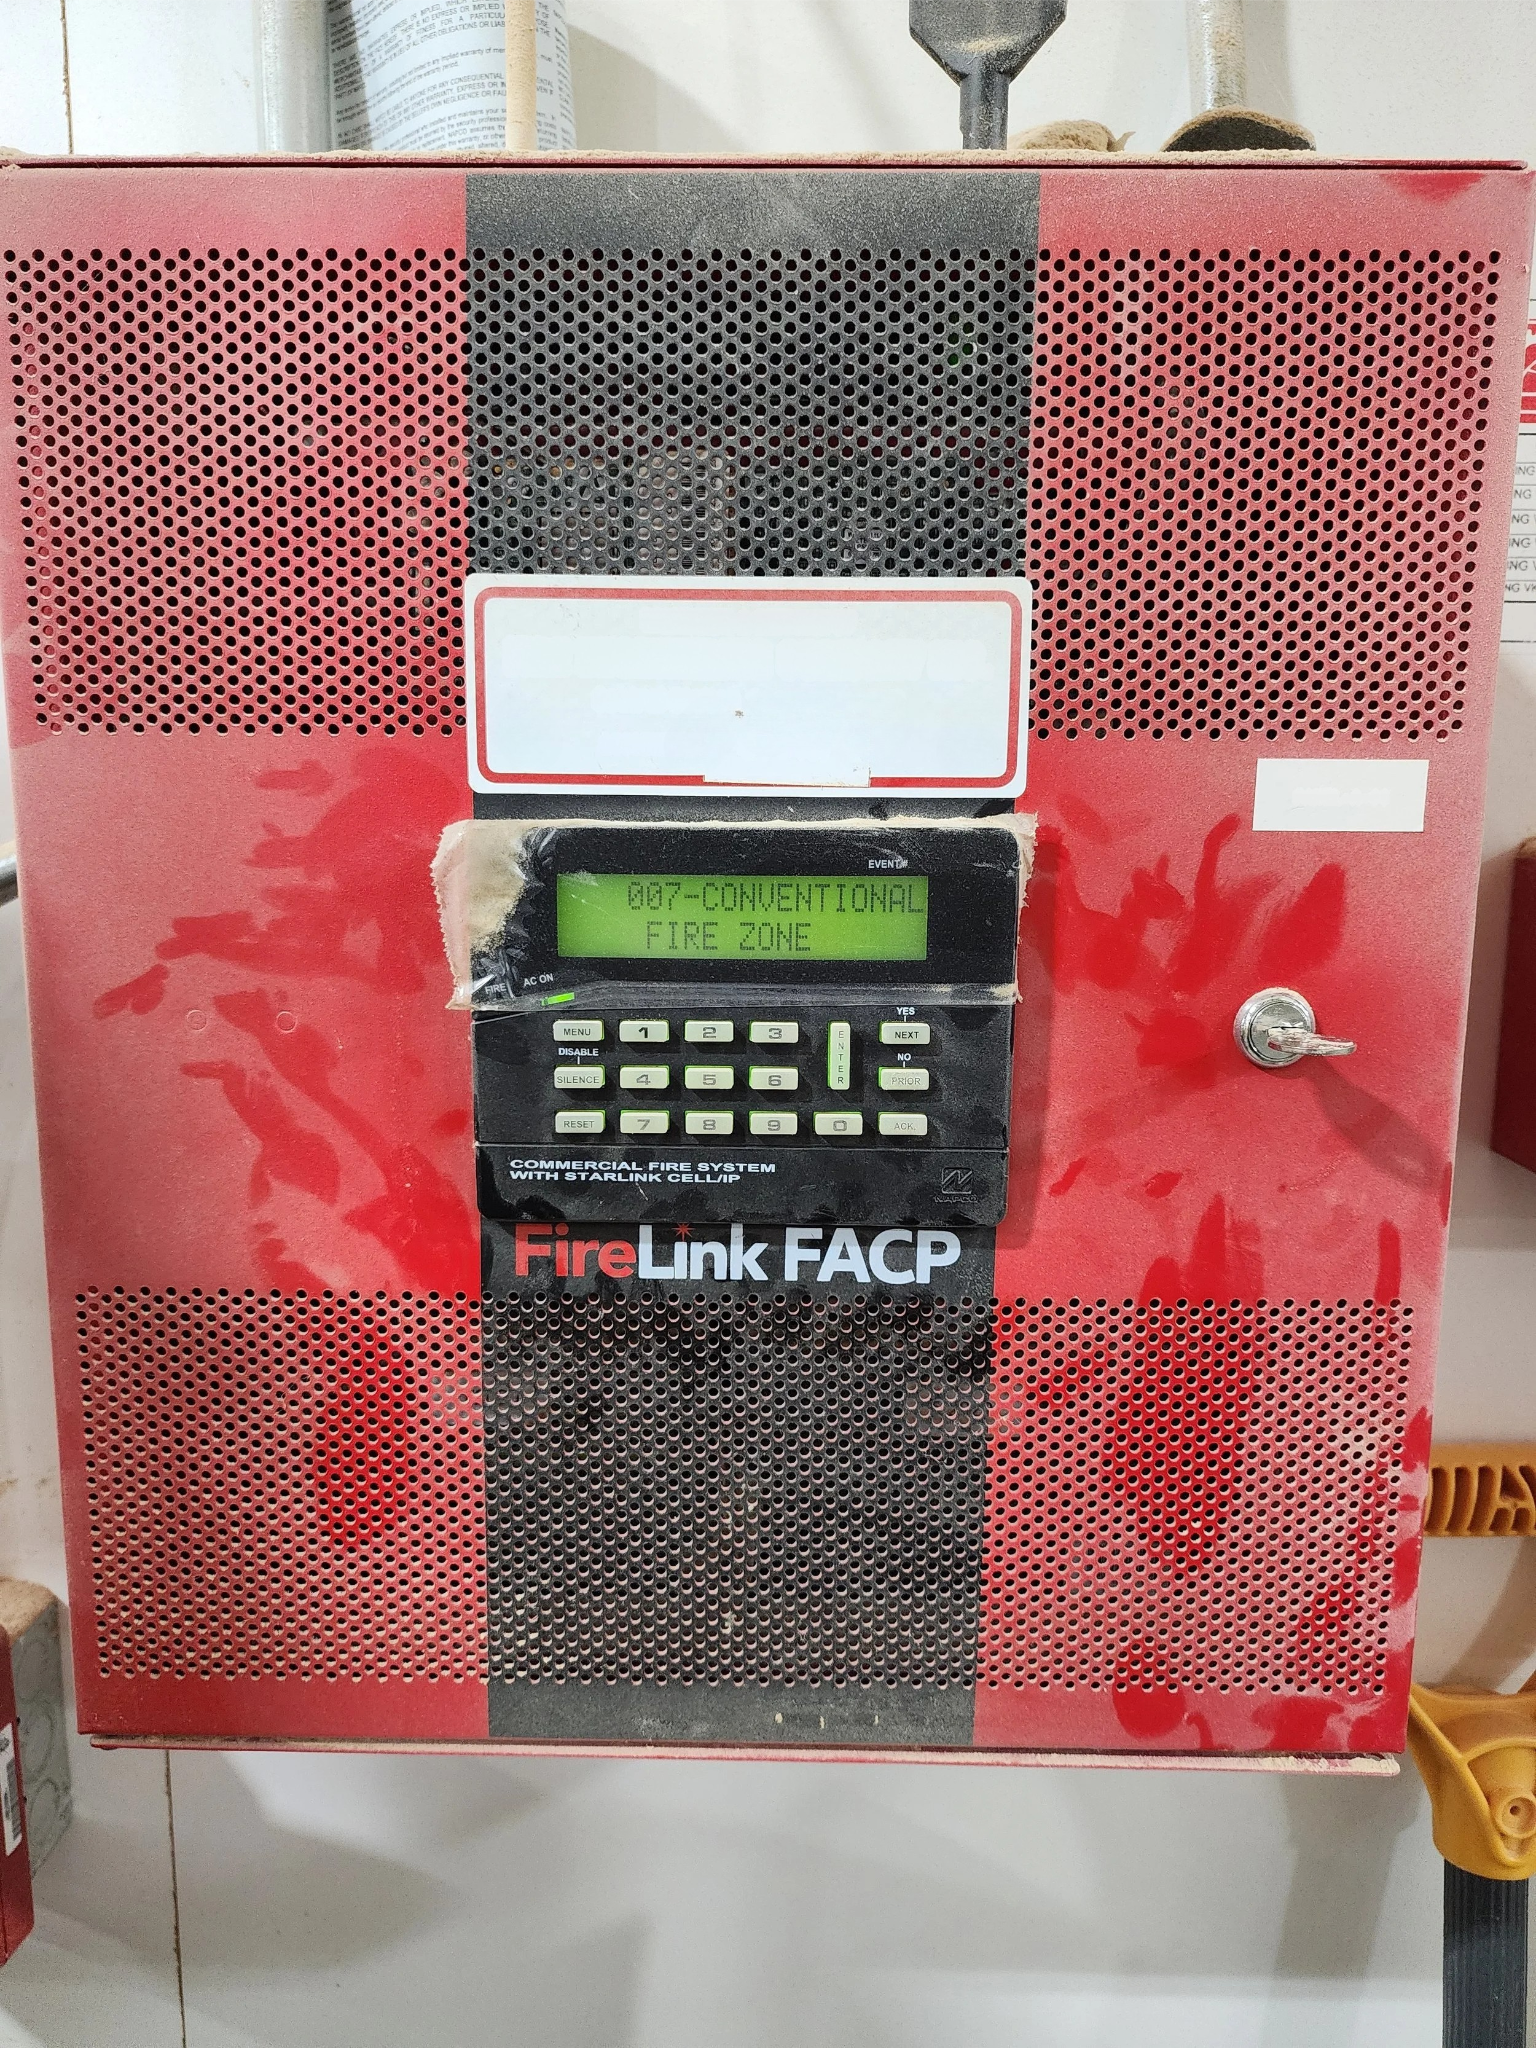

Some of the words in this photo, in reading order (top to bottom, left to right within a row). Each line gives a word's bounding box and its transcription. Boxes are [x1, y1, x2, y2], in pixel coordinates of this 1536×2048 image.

[627, 881, 926, 914] 007-CONVENTIONAL
[646, 921, 719, 951] FIRE
[739, 922, 812, 952] ZONE
[523, 976, 538, 988] AC
[539, 972, 555, 984] ON
[485, 983, 507, 994] FIRE
[896, 1007, 915, 1016] YES
[563, 1028, 591, 1036] MENU
[638, 1026, 649, 1039] 1
[702, 1026, 717, 1039] 2
[768, 1027, 783, 1040] 3
[894, 1031, 920, 1040] NEXT
[558, 1047, 600, 1057] DISABLE
[837, 1030, 845, 1085] ENTER
[897, 1053, 912, 1061] NO
[557, 1075, 600, 1084] SILENCE
[636, 1074, 651, 1086] 4
[702, 1074, 717, 1086] 5
[768, 1075, 782, 1087] 6
[891, 1077, 921, 1085] PRIOR
[563, 1120, 595, 1129] RESET
[637, 1119, 651, 1131] 7
[702, 1119, 717, 1131] 8
[767, 1119, 781, 1132] 9
[509, 1159, 646, 1172] COMMERCIAL
[647, 1161, 694, 1172] FIRE
[697, 1161, 776, 1173] SYSTEM
[509, 1170, 561, 1181] WITH
[563, 1171, 663, 1183] STARLINK
[666, 1171, 741, 1184] CELL/IP
[515, 1222, 769, 1281] FireLink
[784, 1226, 962, 1285] FACP
